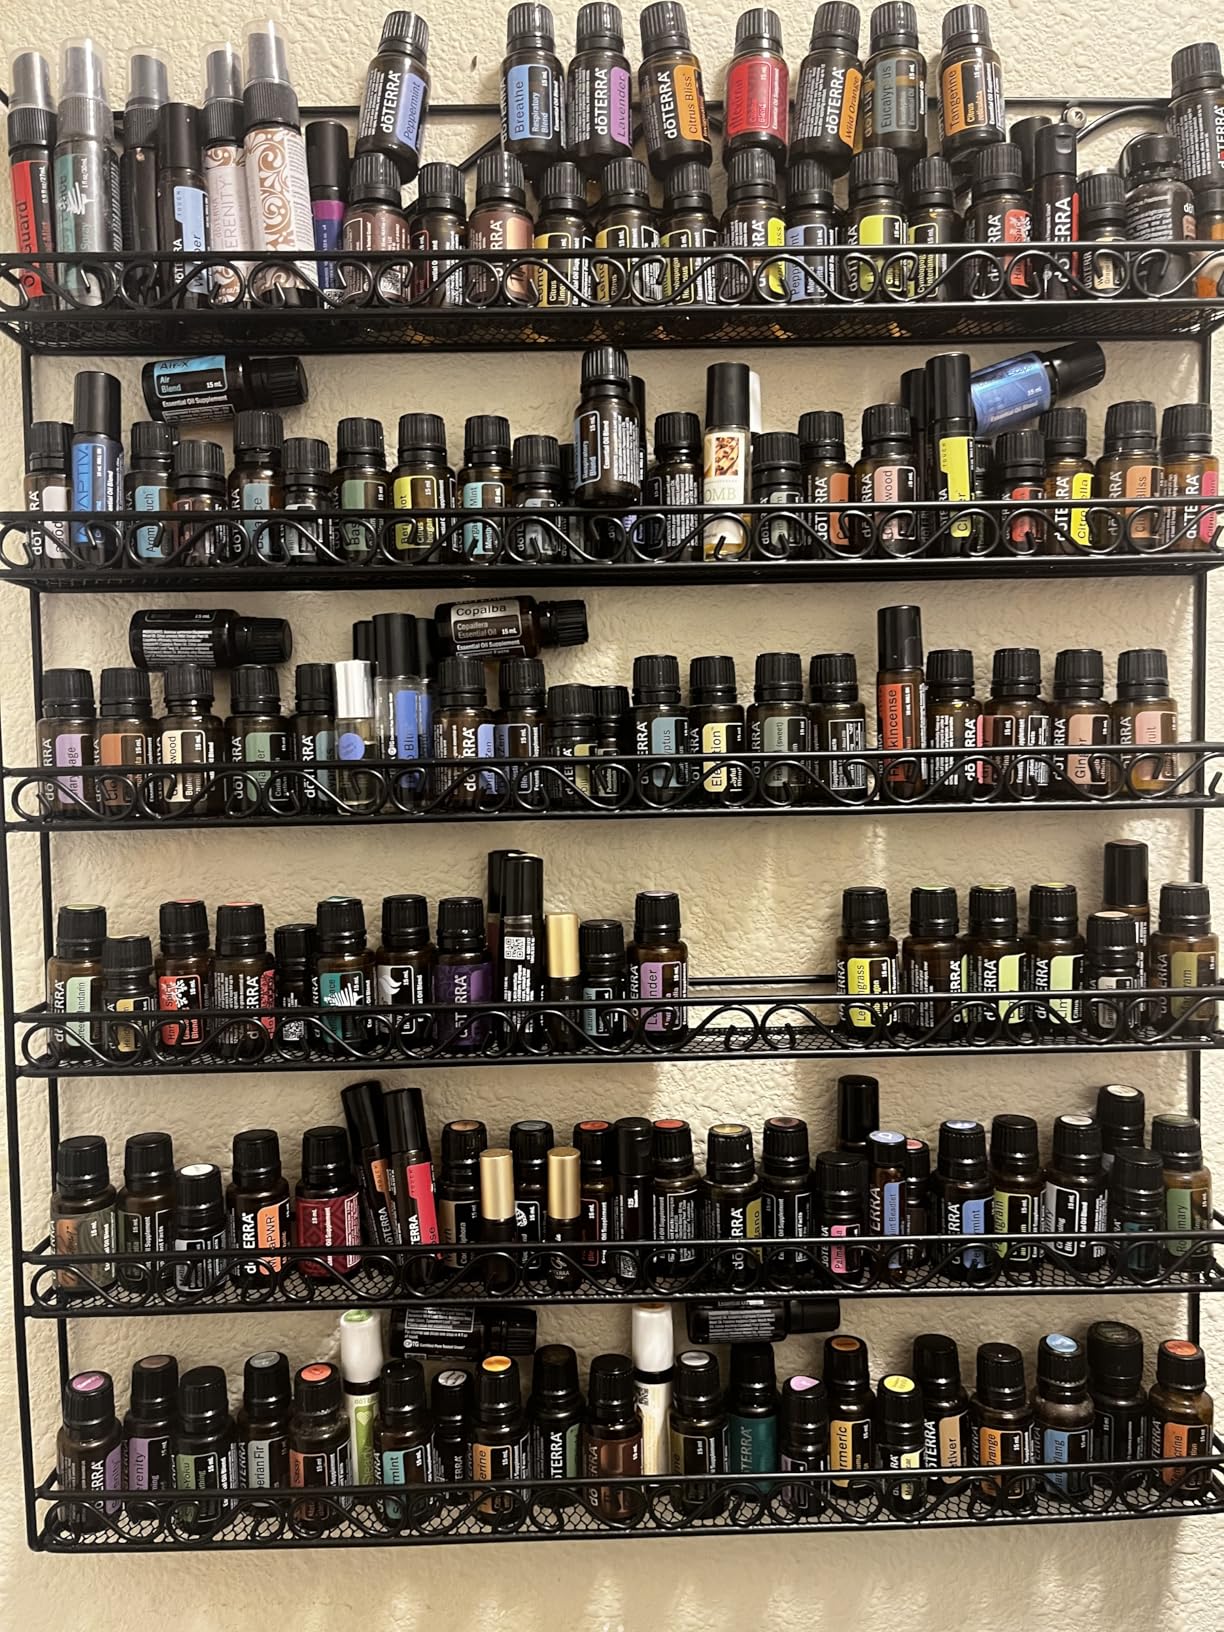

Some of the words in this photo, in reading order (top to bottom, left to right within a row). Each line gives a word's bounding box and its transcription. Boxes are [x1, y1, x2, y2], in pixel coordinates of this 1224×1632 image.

[683, 76, 693, 101] Bliss
[848, 75, 859, 114] Orange
[879, 66, 892, 128] Eucalypus
[946, 70, 960, 128] Tangerine
[403, 78, 421, 140] Peppermint
[513, 80, 524, 134] Breathe
[532, 92, 541, 132] Respiratory
[615, 76, 626, 137] Lavender
[687, 104, 698, 134] Citrus
[967, 103, 975, 122] Citrus
[541, 113, 549, 133] Blend
[844, 116, 854, 139] Wild
[225, 176, 237, 249] ERENITY
[80, 222, 90, 250] Spray
[160, 376, 170, 384] Air
[161, 383, 182, 393] Blend
[469, 487, 478, 506] Mint
[1076, 479, 1088, 539] Citrolla
[456, 604, 506, 617] Copaiba
[458, 630, 487, 639] Essential
[489, 640, 520, 648] Supplement
[775, 722, 785, 747] (sweet)
[710, 730, 723, 787] Eletion
[647, 969, 657, 1024] Lander
[856, 965, 867, 1021] Lengrass
[191, 1019, 199, 1038] Blend
[888, 1194, 897, 1222] Beadlet
[1175, 1204, 1187, 1252] Romary
